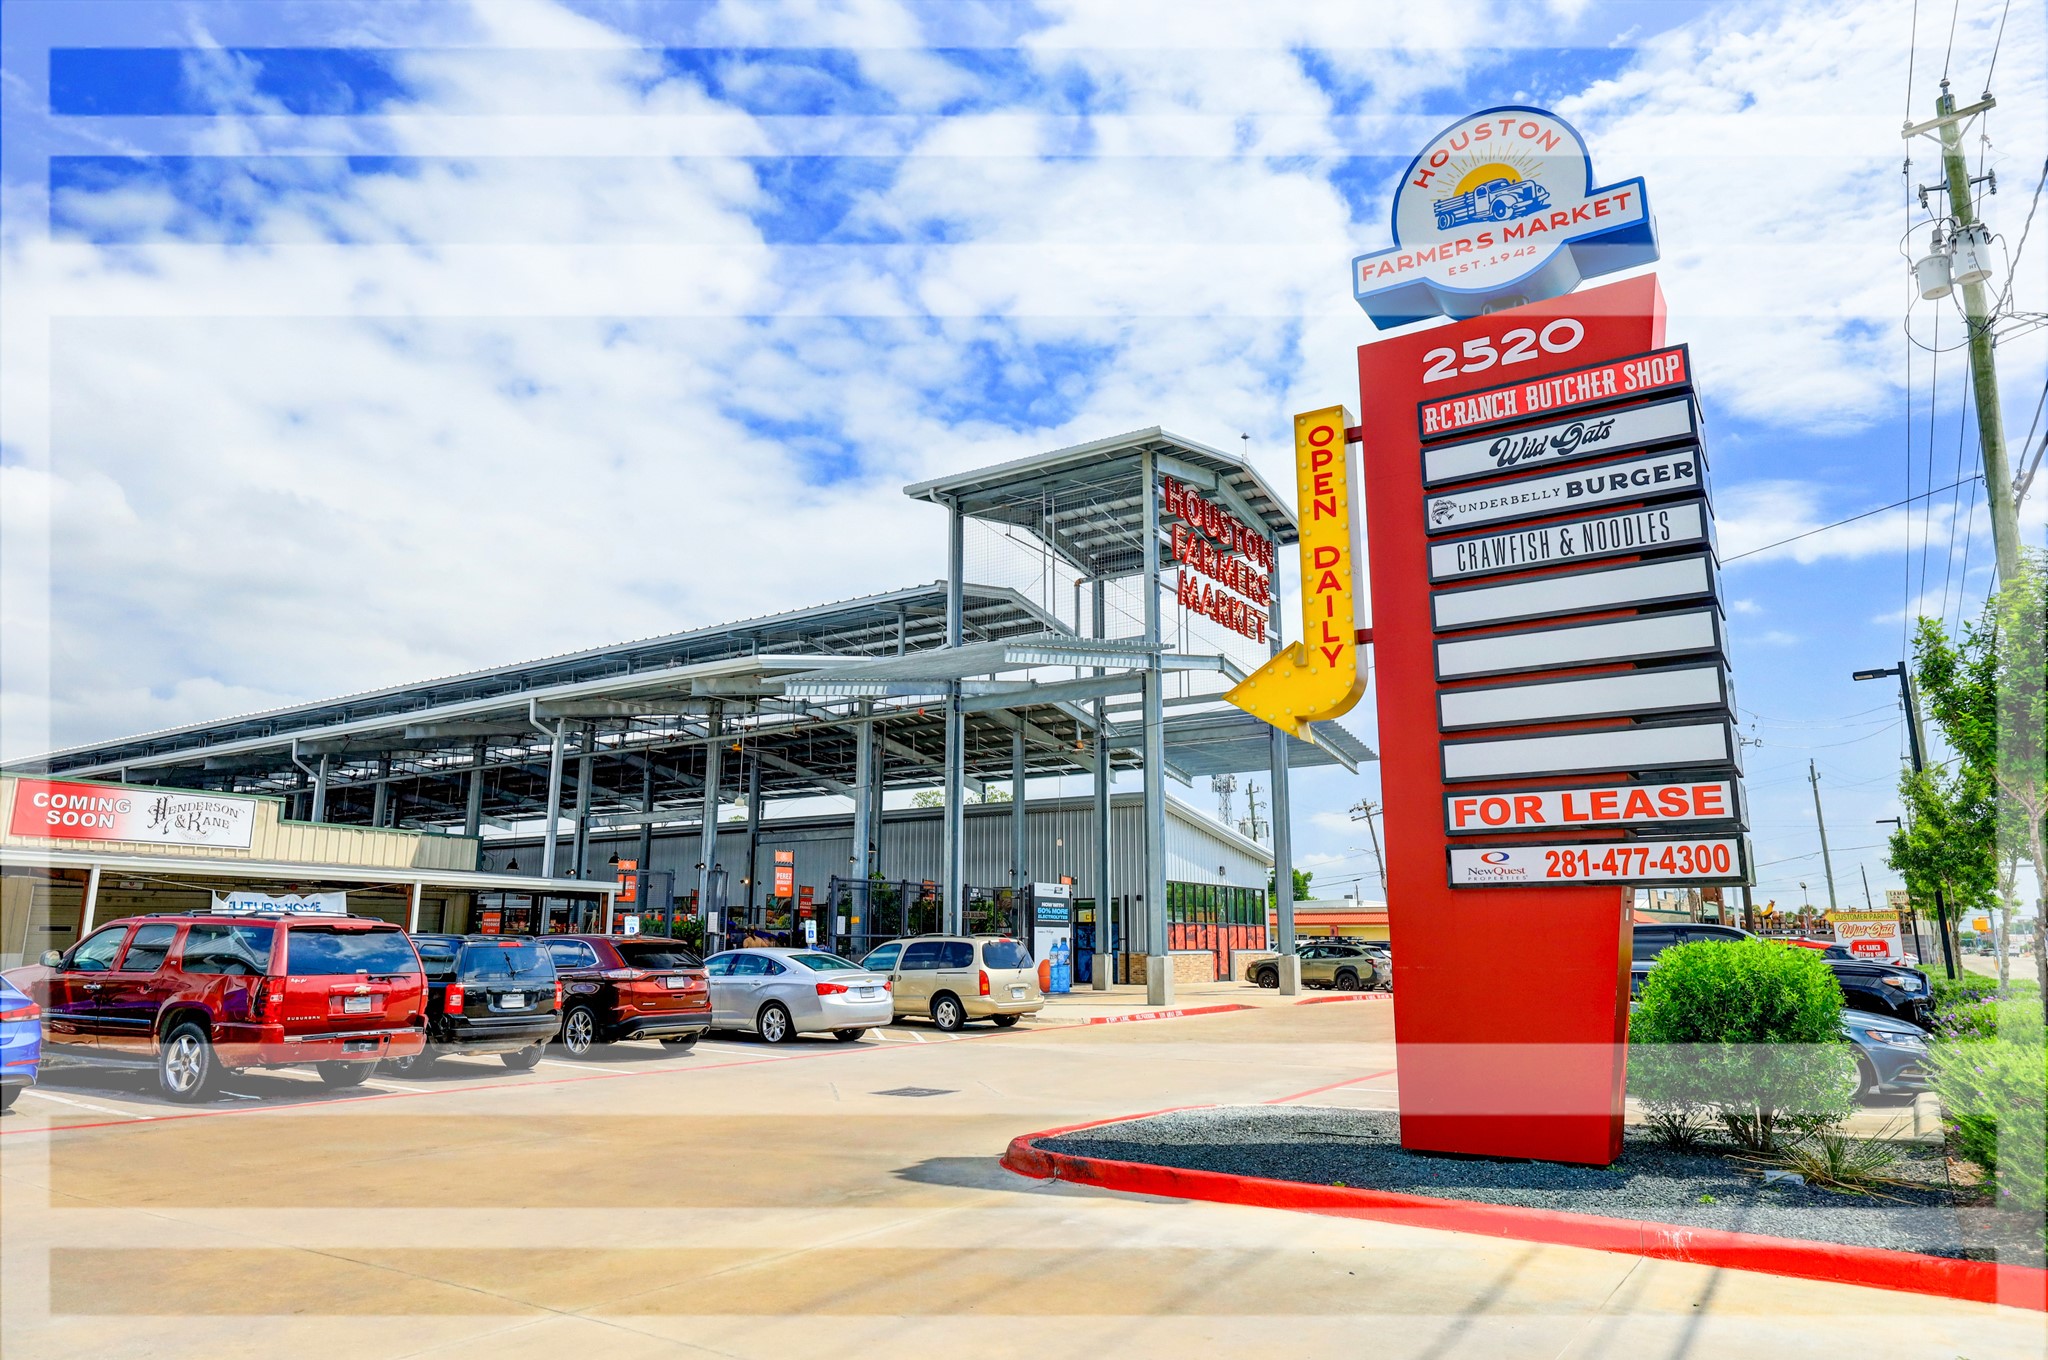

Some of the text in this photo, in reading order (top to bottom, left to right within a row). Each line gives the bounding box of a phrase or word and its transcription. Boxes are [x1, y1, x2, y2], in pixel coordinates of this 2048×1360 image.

[1413, 119, 1561, 189] HOUSTON
[1362, 192, 1631, 281] FARMERS MARKET
[1422, 318, 1585, 384] 2520
[1454, 389, 1518, 426] RANCH
[1526, 369, 1617, 412] BUTCHER
[1623, 354, 1680, 390] SHOP
[1489, 418, 1616, 467] Wild Oats
[1458, 461, 1694, 513] UNDERBELLY BURGER
[1165, 475, 1274, 573] HOUSTON
[1308, 425, 1344, 668] OPEN DAILY
[1457, 510, 1670, 572] CRAWFISH & NOODLES
[1171, 523, 1271, 607] FARMERS
[1178, 569, 1268, 644] MARKET
[33, 792, 132, 813] COMING
[46, 810, 115, 829] SOON
[147, 795, 241, 834] HENDERSON
[174, 810, 231, 834] & KANE
[1454, 785, 1725, 827] FOR LEASE
[777, 872, 792, 880] PEREZ
[1468, 866, 1526, 876] NewQuest
[1545, 844, 1730, 878] 281-477-4300
[285, 901, 322, 912] HOME
[1869, 912, 1897, 920] PARKING
[1838, 922, 1896, 938] Wild Oats
